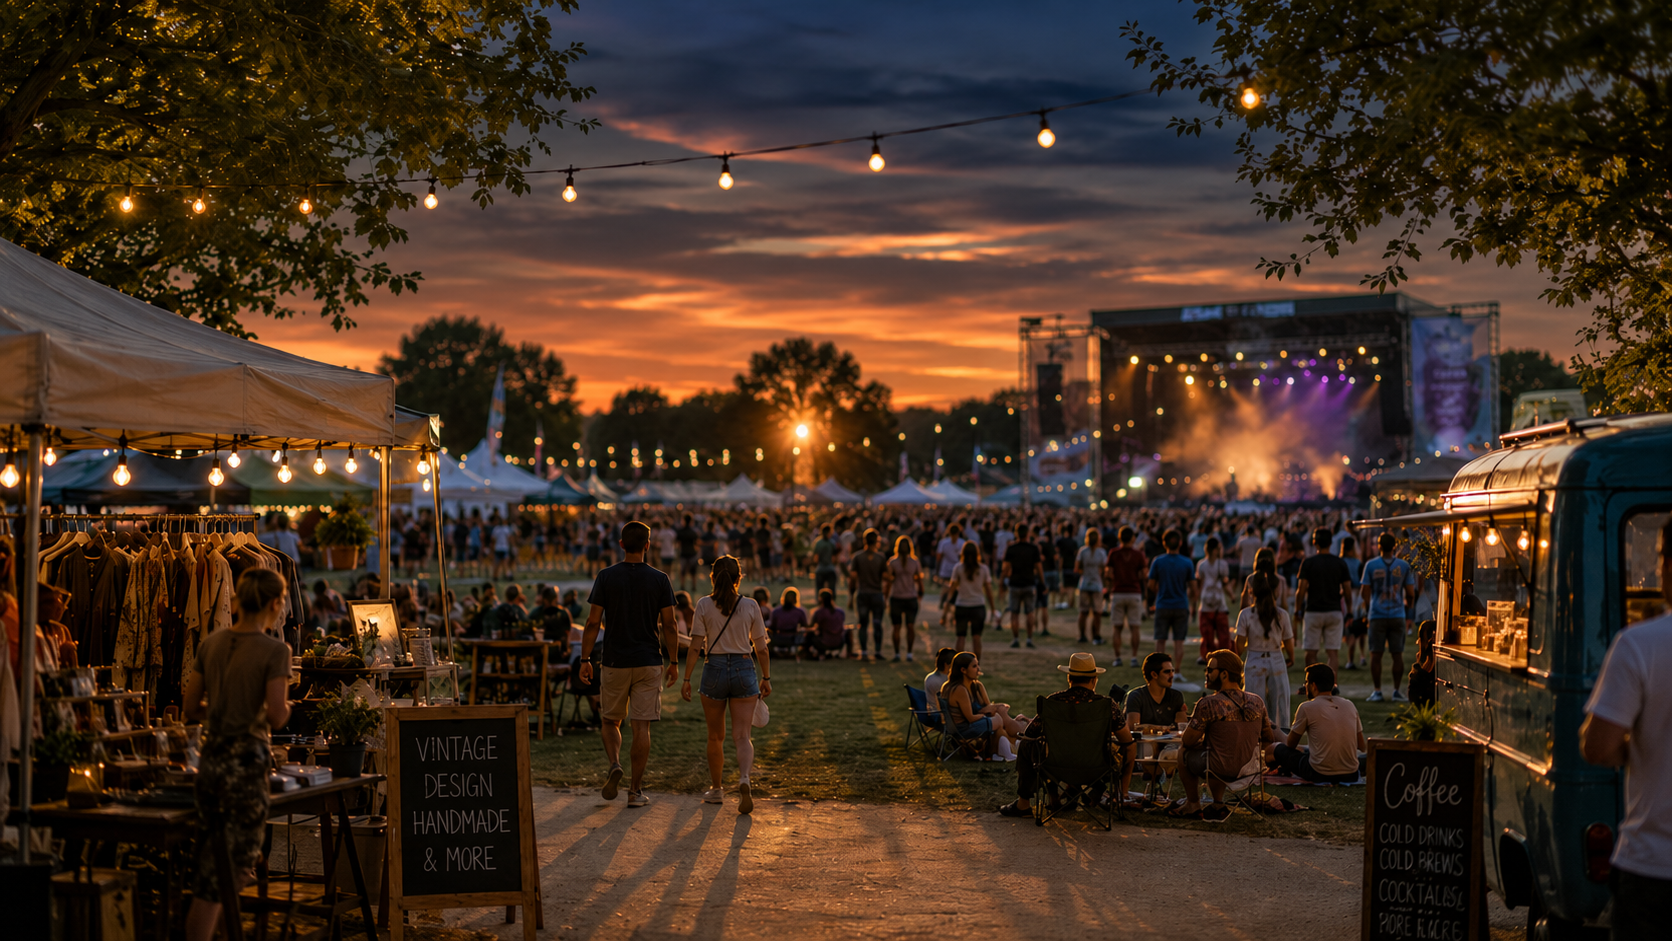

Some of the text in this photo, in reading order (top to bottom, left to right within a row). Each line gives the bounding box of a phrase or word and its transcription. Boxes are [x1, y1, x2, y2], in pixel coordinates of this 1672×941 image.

[415, 735, 498, 762] VINTAGE
[424, 773, 493, 799] DESIGN
[1384, 762, 1463, 817] Coffee
[413, 809, 511, 835] HANDMADE
[1379, 822, 1464, 849] COLD DRINKS
[423, 845, 497, 872] & MORE
[1379, 848, 1464, 877] COLD BREWS
